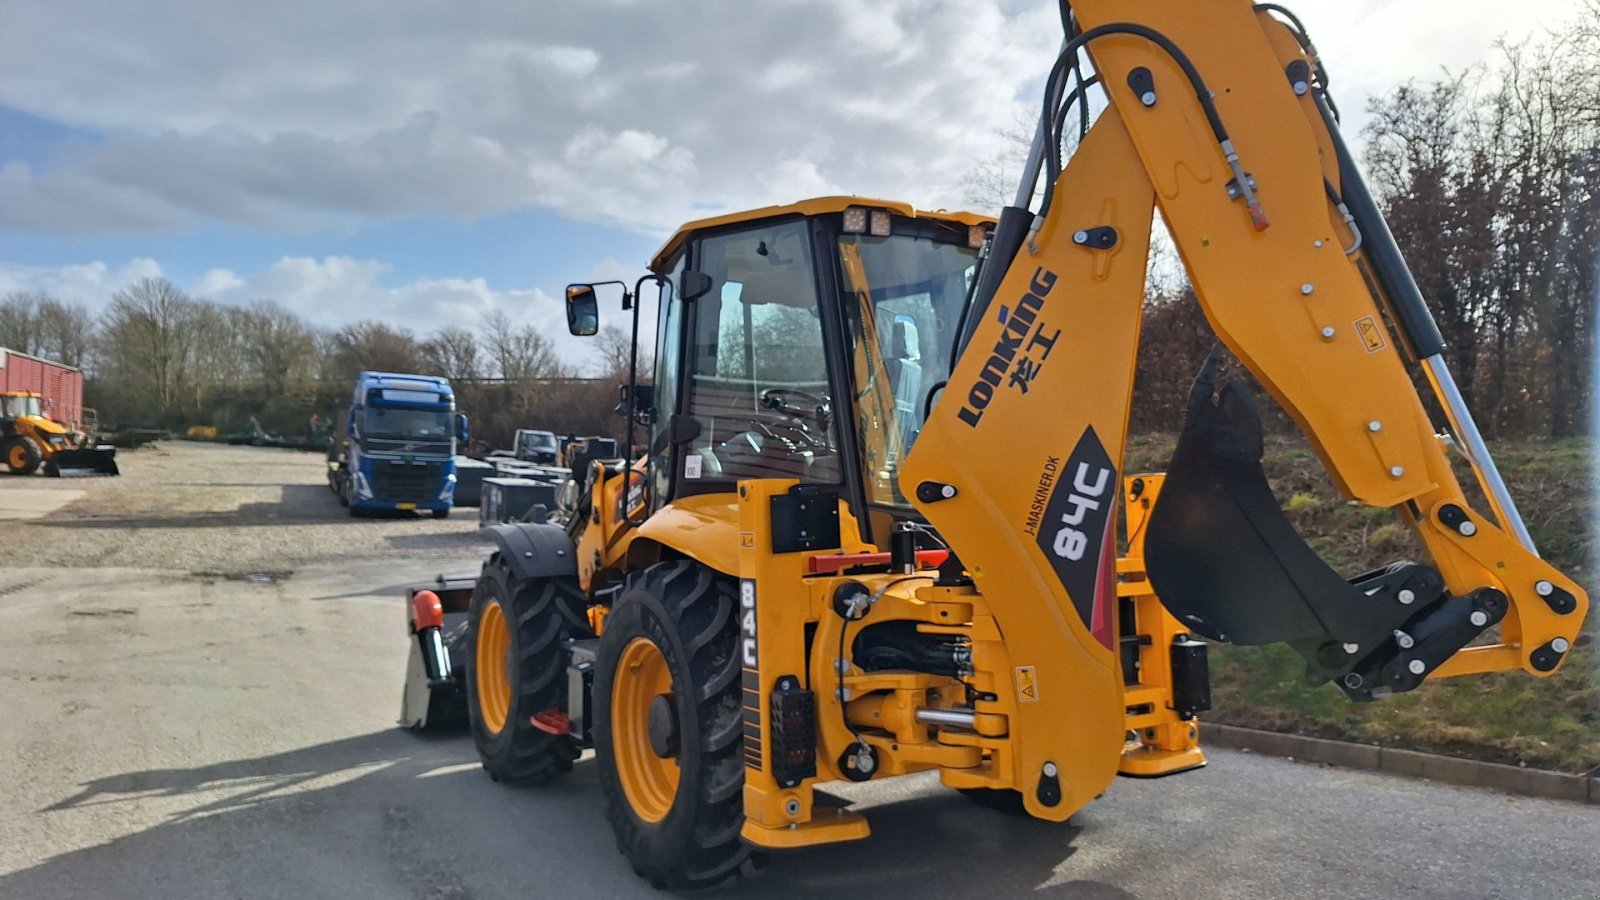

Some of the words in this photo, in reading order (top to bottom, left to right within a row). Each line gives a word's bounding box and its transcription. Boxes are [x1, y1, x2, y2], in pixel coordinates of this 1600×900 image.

[1008, 322, 1061, 394] 龙工
[1024, 455, 1060, 536] J-MASKINER.DK
[1053, 462, 1110, 561] 84C
[742, 581, 757, 666] 84C
